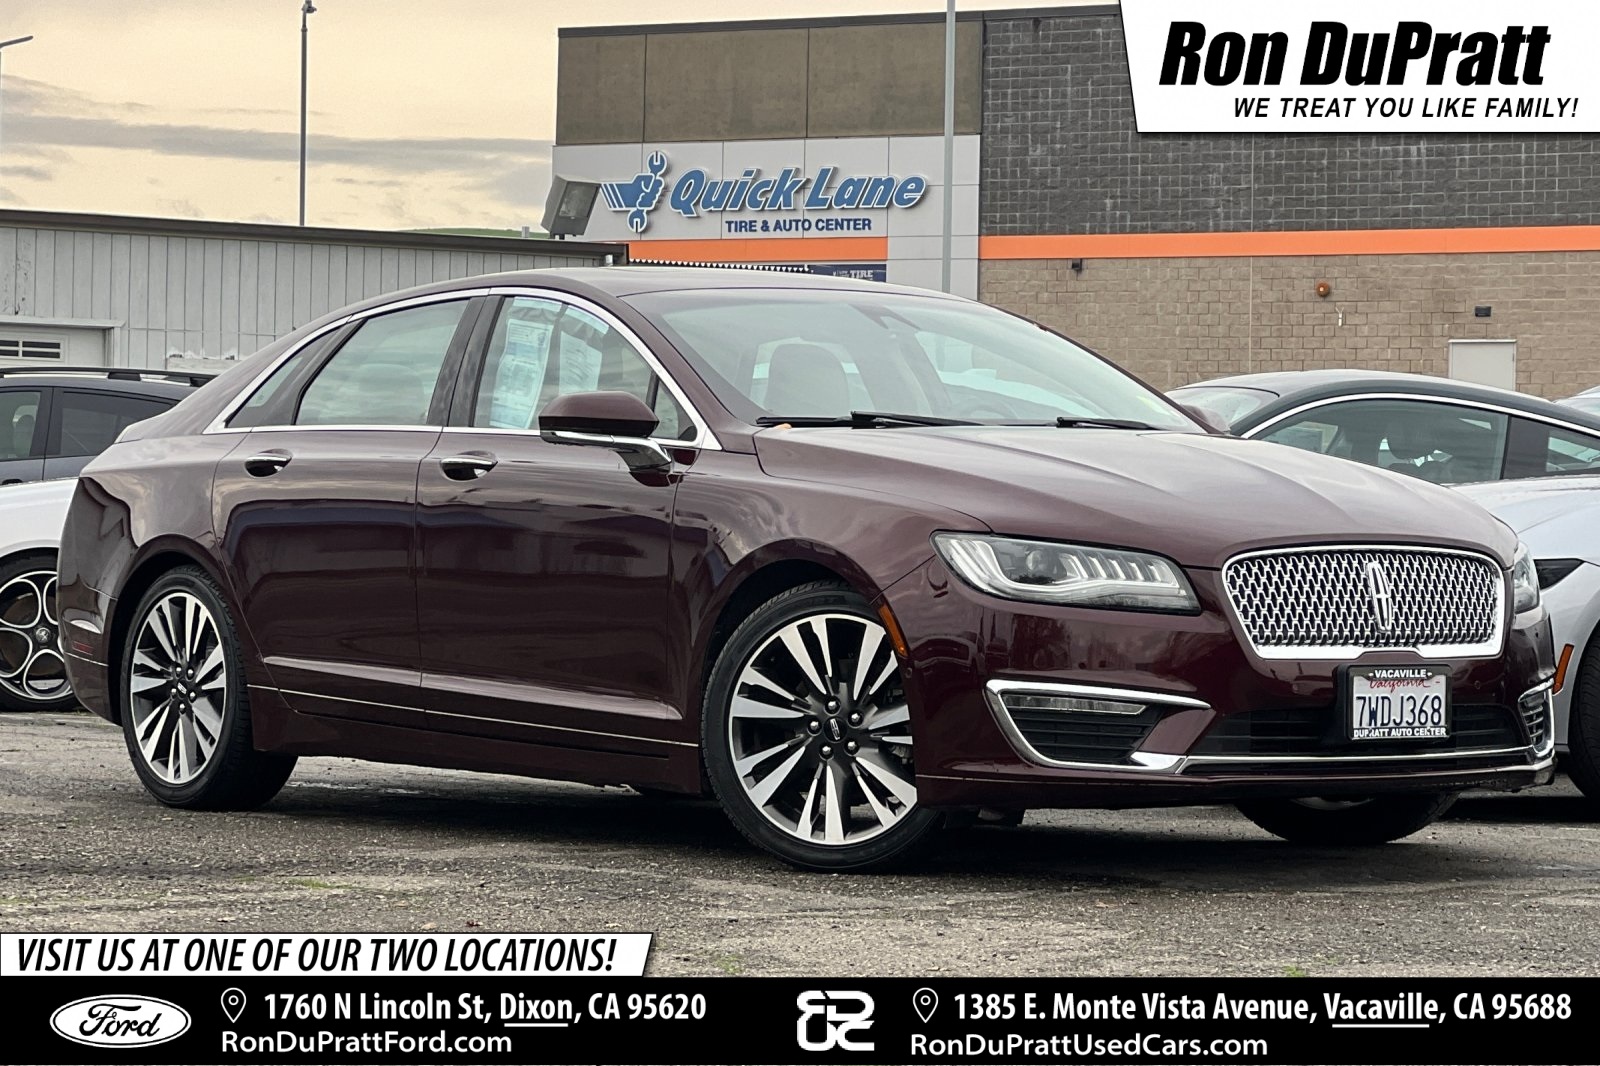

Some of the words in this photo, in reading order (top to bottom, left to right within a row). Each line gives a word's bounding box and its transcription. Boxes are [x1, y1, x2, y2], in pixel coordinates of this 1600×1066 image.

[670, 167, 810, 217] Quick
[803, 166, 927, 209] Lane
[725, 219, 758, 233] TIRE
[760, 219, 771, 232] &
[773, 218, 812, 232] AUTO
[815, 217, 872, 232] CENTER
[850, 269, 874, 279] TIRE
[1374, 669, 1427, 679] VACAVILLE
[1355, 694, 1443, 727] 7WDJ368
[1391, 727, 1412, 737] AUTO
